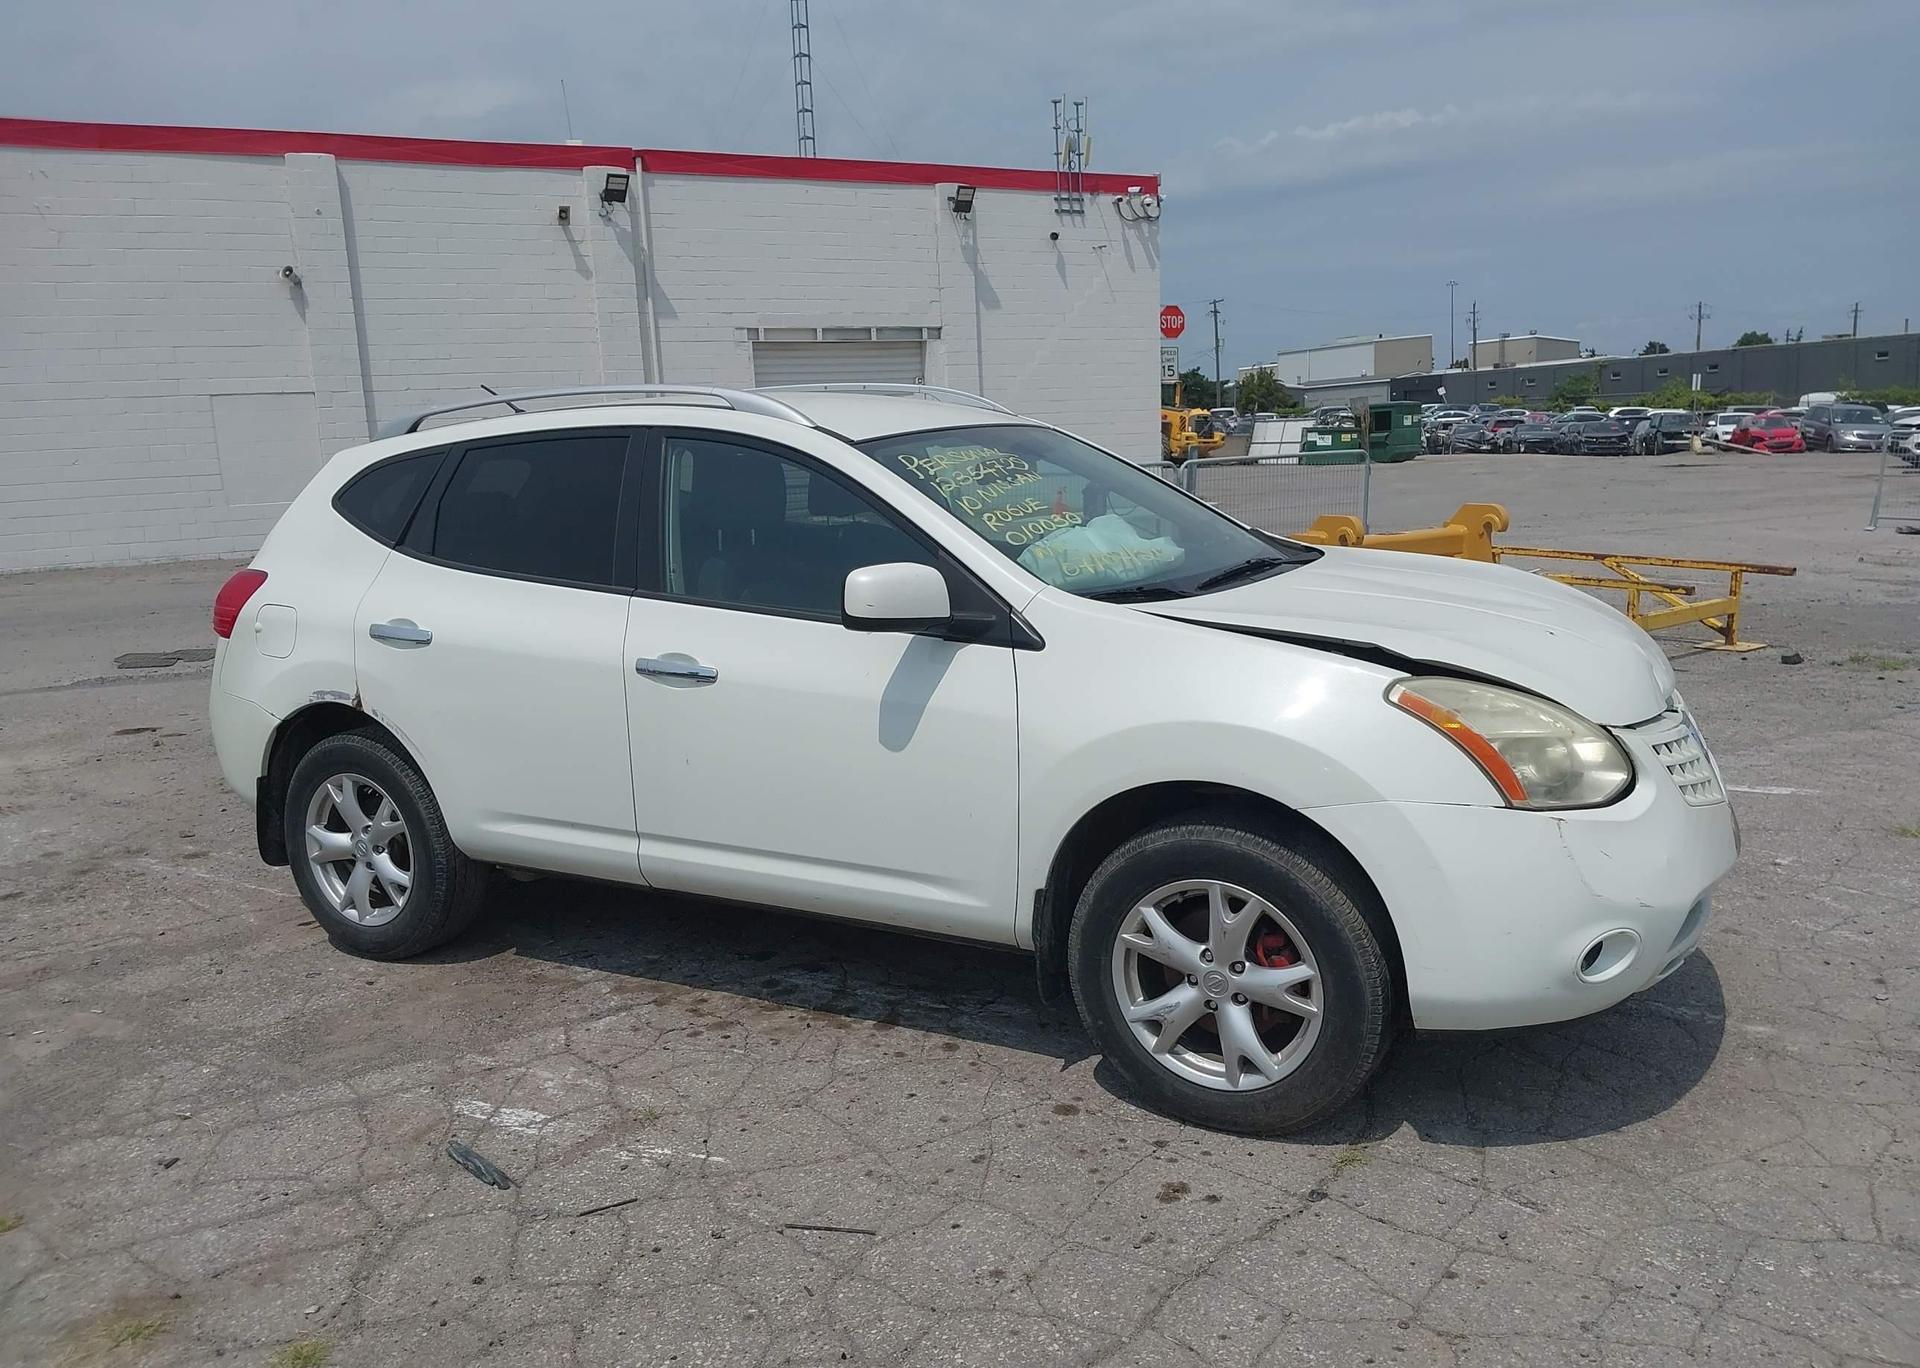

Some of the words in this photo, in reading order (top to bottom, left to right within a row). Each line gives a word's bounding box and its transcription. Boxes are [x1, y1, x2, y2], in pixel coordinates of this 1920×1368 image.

[1161, 316, 1183, 328] STOP
[1162, 364, 1175, 377] 15
[954, 495, 983, 517] 10
[976, 470, 1042, 503] NISSAN
[981, 497, 1049, 532] ROGUE
